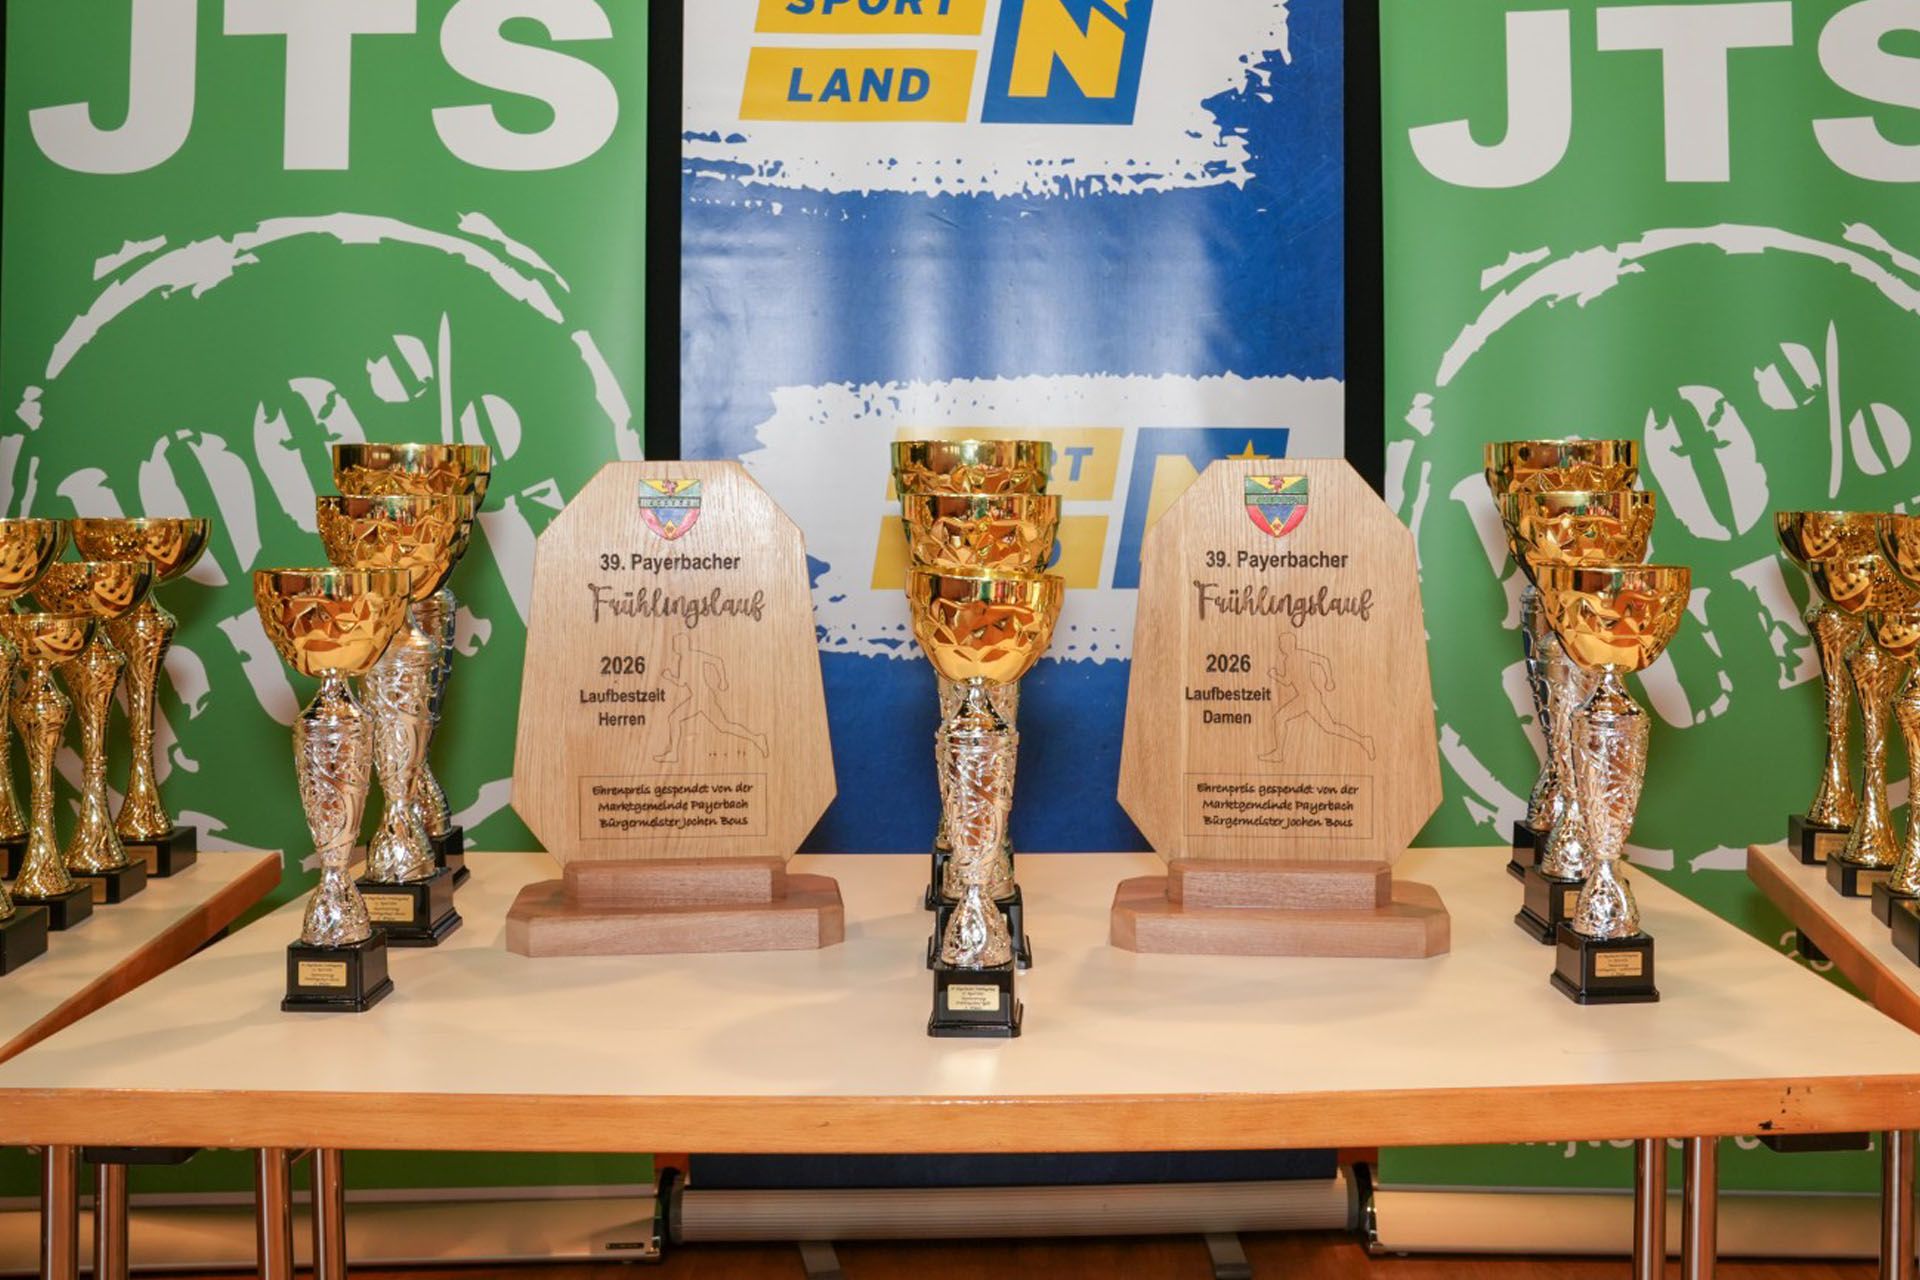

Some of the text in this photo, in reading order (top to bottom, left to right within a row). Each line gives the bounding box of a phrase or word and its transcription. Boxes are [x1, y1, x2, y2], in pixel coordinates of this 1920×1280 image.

[29, 0, 620, 174] JTS
[787, 67, 931, 103] LAND
[600, 553, 741, 575] 39. Payerbacher
[1205, 550, 1349, 572] 39. Payerbacher
[588, 582, 766, 629] Frühlingslauf
[1193, 579, 1374, 628] Frühlingslauf
[600, 656, 646, 675] 2026
[1205, 653, 1251, 673] 2026
[580, 689, 666, 704] Laufbestzeit
[1185, 686, 1271, 701] Laufbestzeit
[598, 712, 646, 726] Herren
[1203, 709, 1252, 724] Damen
[592, 781, 753, 800] Ehrenpreis gespendet von der
[1196, 782, 1359, 797] Ehrenpreis gespendet von der
[598, 799, 749, 815] Marktgemeinde Payerbach
[1202, 799, 1354, 815] Marktgemeinde Payerbach
[599, 816, 681, 831] Bürgermeister
[1202, 815, 1284, 829] Bürgermeister
